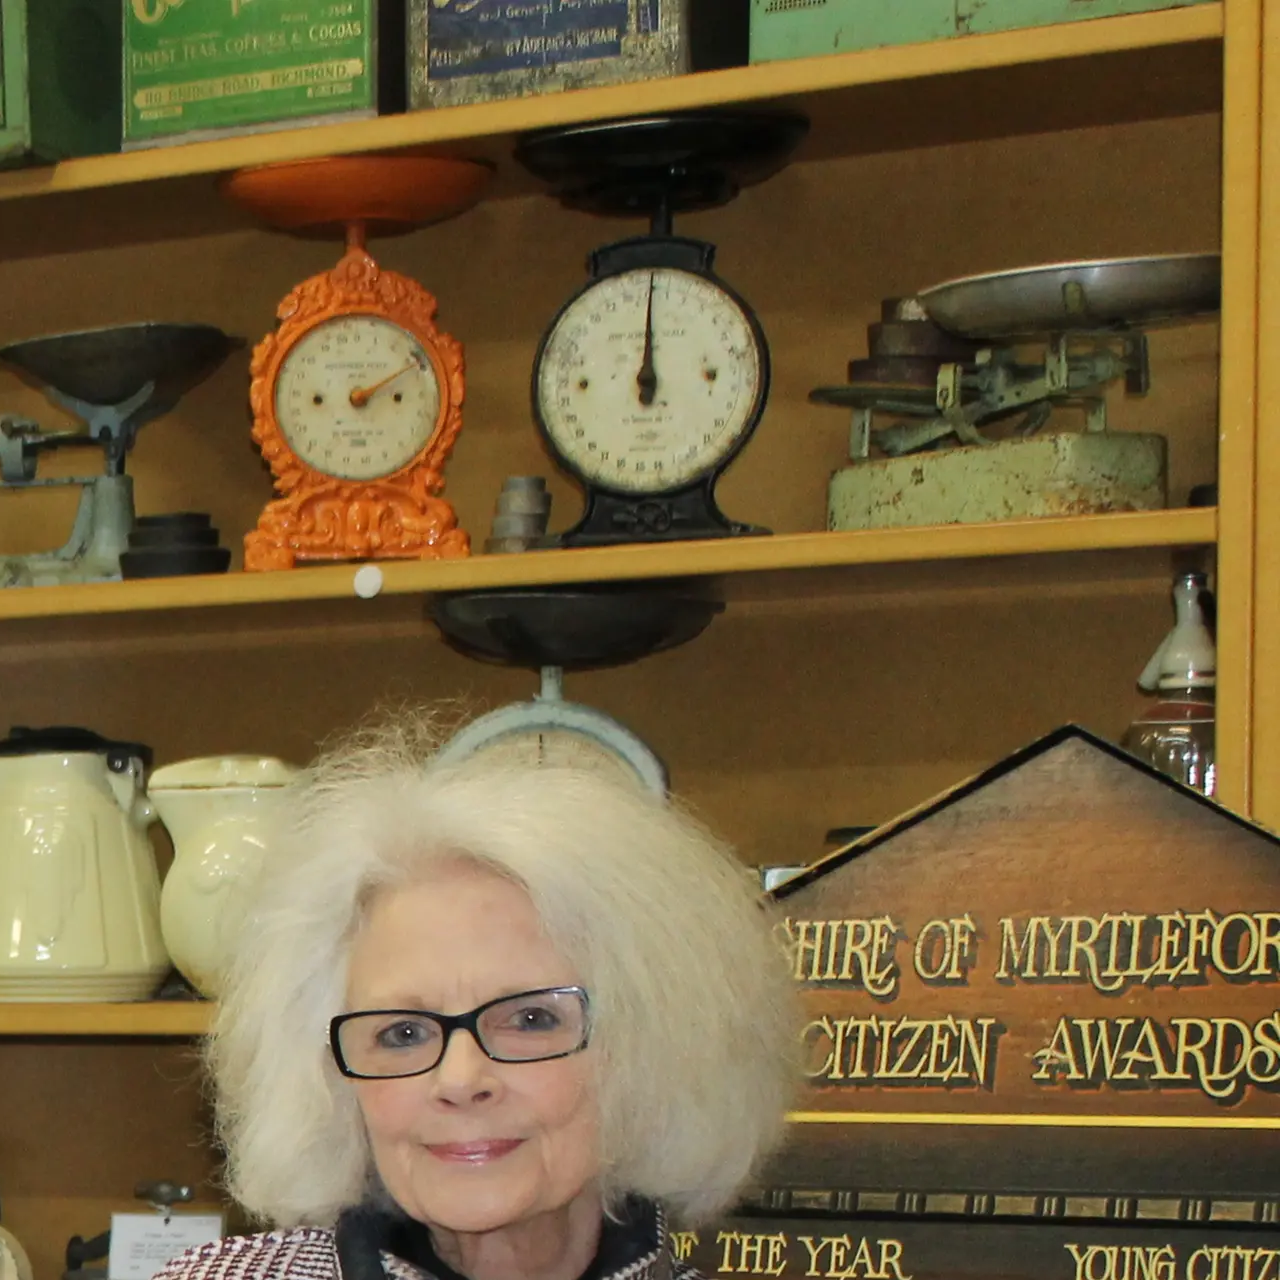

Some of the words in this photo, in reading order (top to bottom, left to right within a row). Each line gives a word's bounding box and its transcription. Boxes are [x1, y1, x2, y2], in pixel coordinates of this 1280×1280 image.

[309, 21, 361, 42] COCOAS
[914, 913, 976, 980] OF
[799, 1015, 996, 1083] CITIZEN
[1031, 1012, 1280, 1099] AWARDS
[716, 1231, 787, 1277] THE
